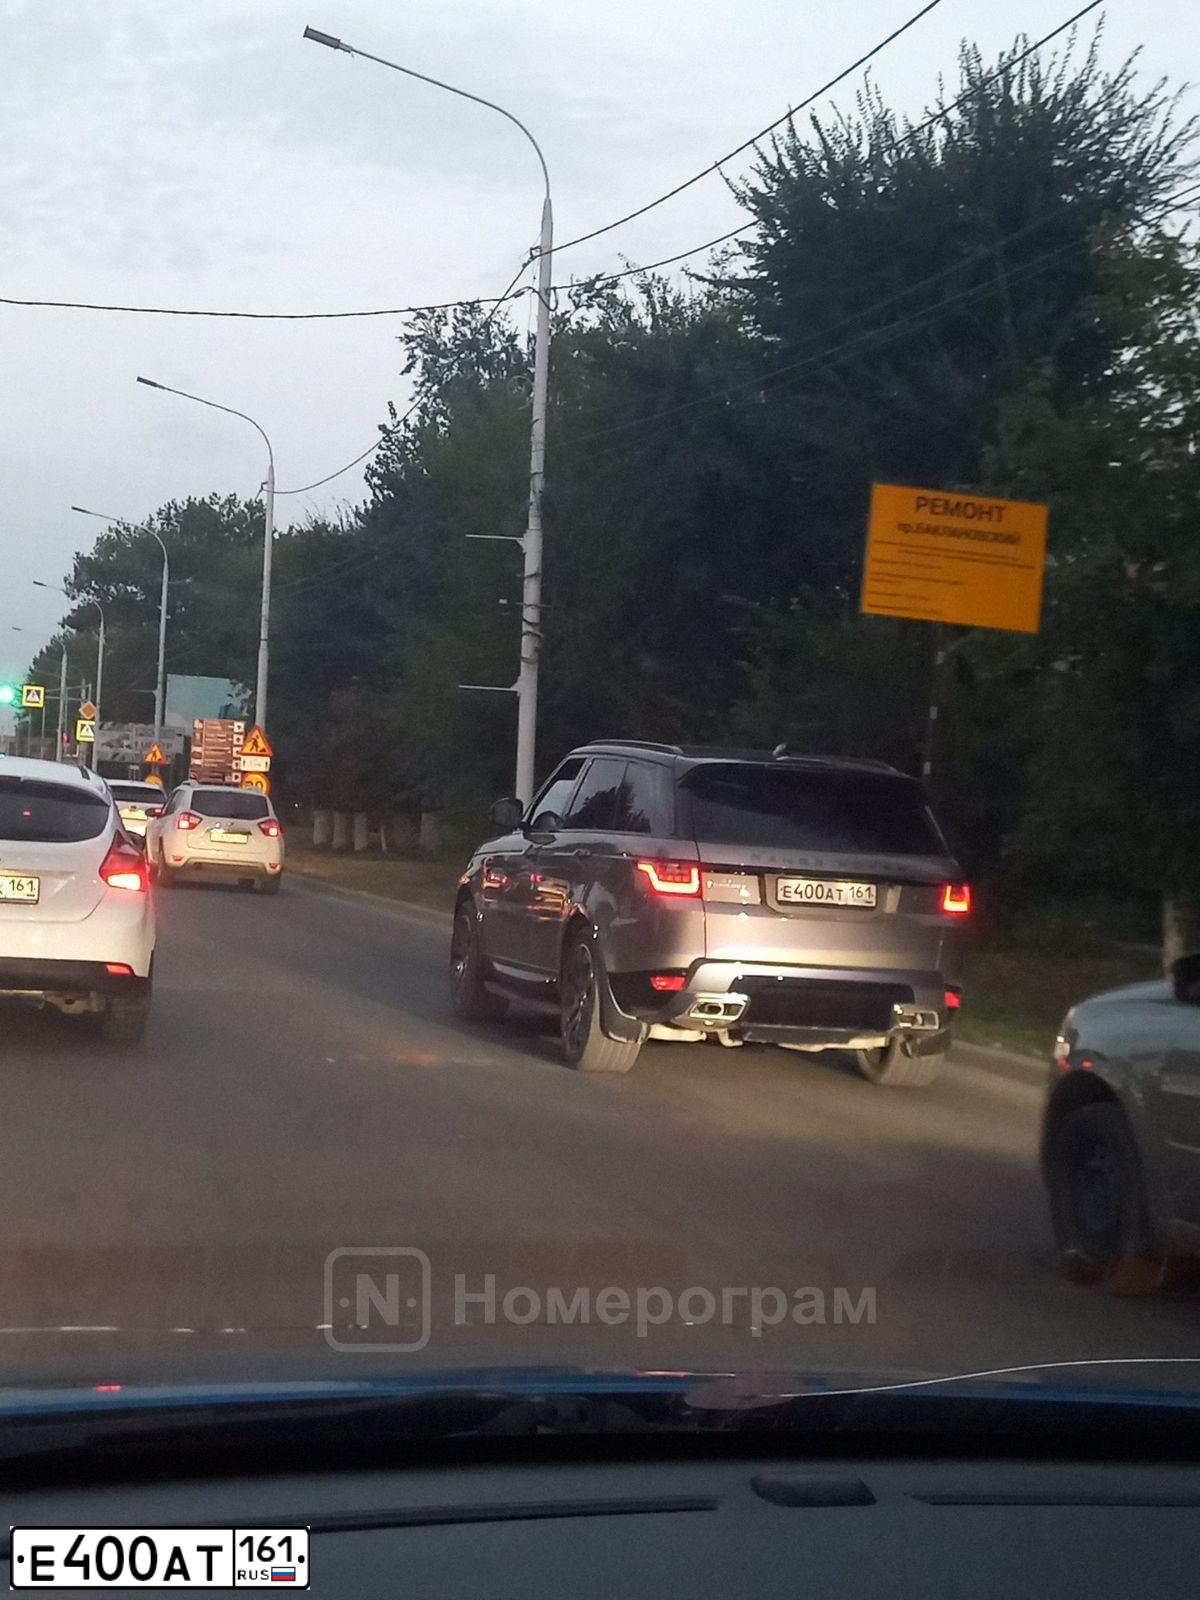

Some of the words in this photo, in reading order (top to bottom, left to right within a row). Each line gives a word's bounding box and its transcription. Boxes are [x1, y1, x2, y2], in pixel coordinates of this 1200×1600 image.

[915, 495, 1006, 523] РЕМОНТ
[9, 878, 34, 892] 161
[782, 883, 844, 901] Е400АТ
[849, 885, 873, 899] 161
